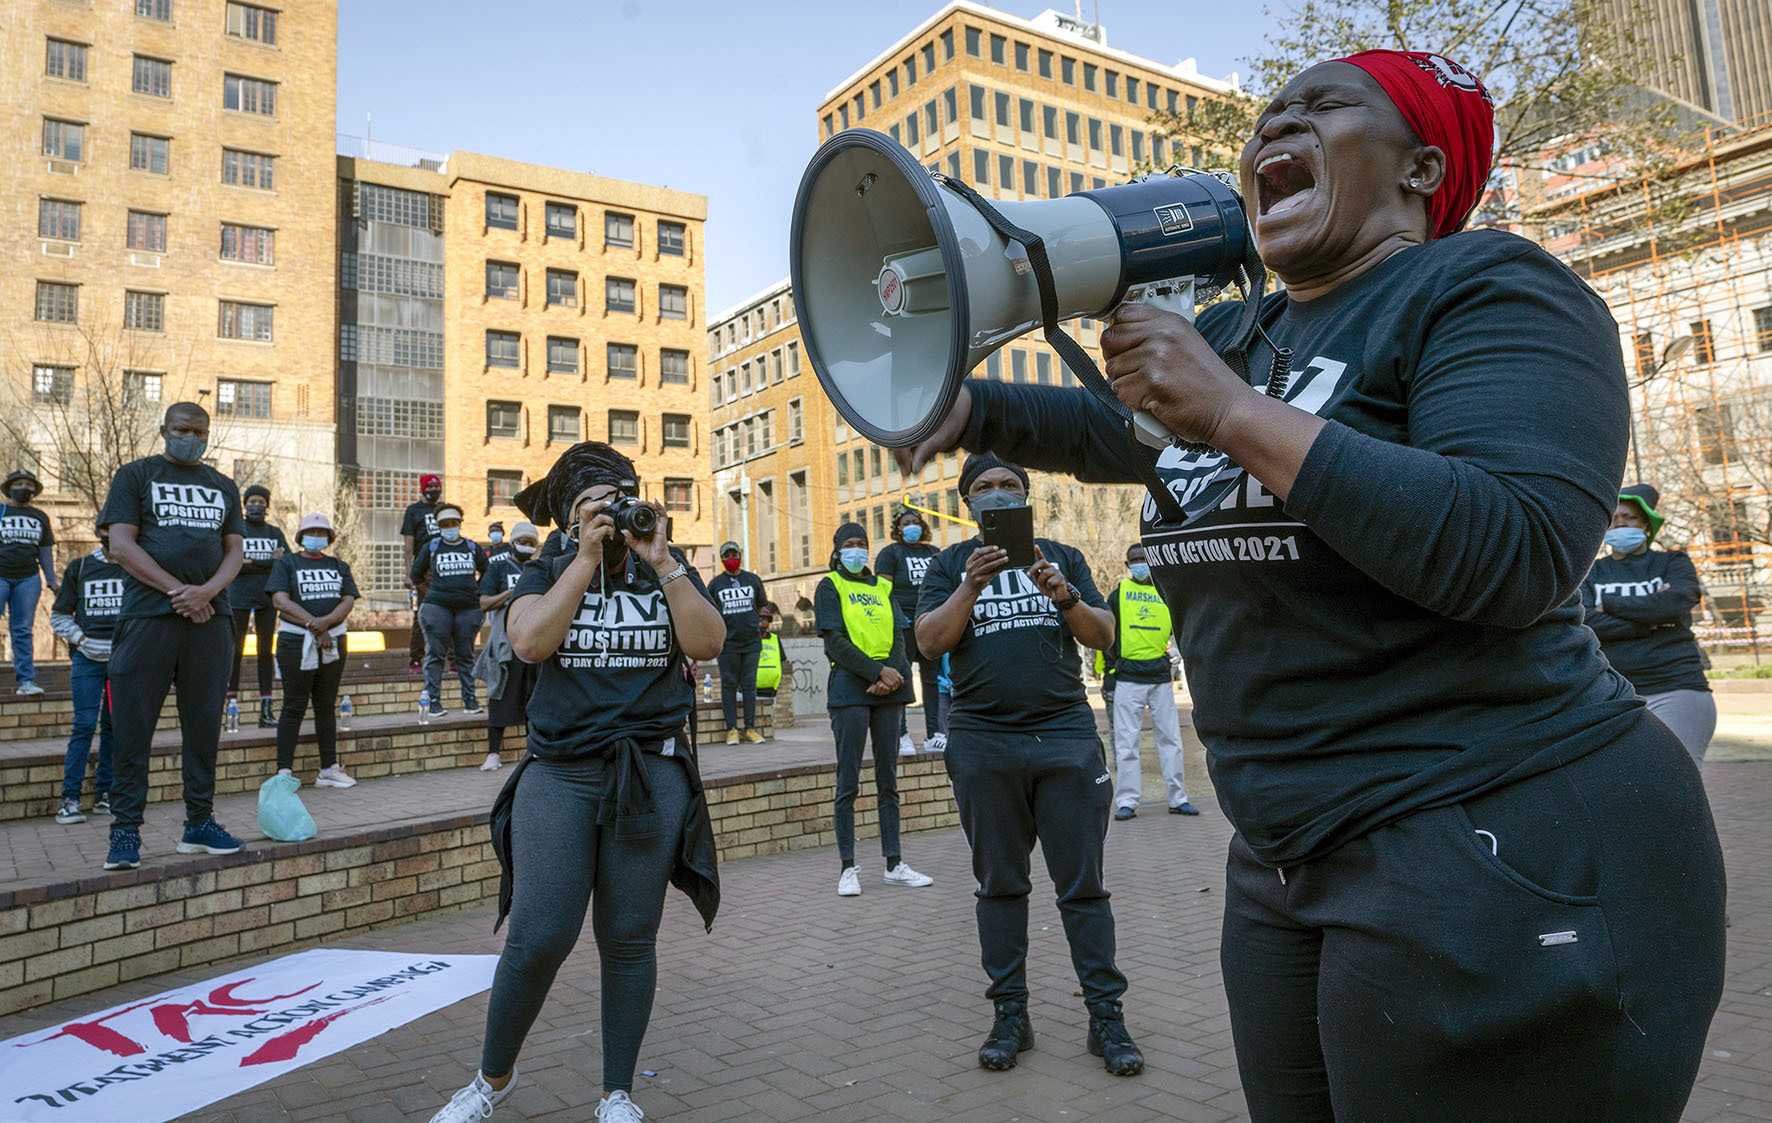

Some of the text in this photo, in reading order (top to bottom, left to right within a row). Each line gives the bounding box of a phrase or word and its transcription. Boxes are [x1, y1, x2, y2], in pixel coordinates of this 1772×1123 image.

[158, 486, 218, 504] HIV
[159, 504, 222, 521] POSITIVE
[2, 518, 38, 529] HIV
[246, 539, 276, 551] HIV
[1162, 543, 1180, 565] OF
[1180, 538, 1236, 565] ACTION
[1233, 536, 1300, 561] 2021
[440, 553, 470, 562] HIV
[302, 571, 338, 581] HIV
[88, 597, 122, 608] POSIT
[722, 588, 751, 600] HIV
[573, 593, 661, 624] HIV
[974, 627, 985, 637] GP
[985, 621, 1001, 634] DAY
[1001, 620, 1013, 630] OF
[1013, 617, 1045, 628] ACTION
[563, 629, 667, 650] POSITIVE
[572, 657, 593, 668] DAY
[594, 656, 608, 668] OF
[608, 656, 646, 668] ACTION
[645, 657, 668, 668] 2021
[13, 977, 324, 1058] TAC
[226, 999, 329, 1039] ACTION
